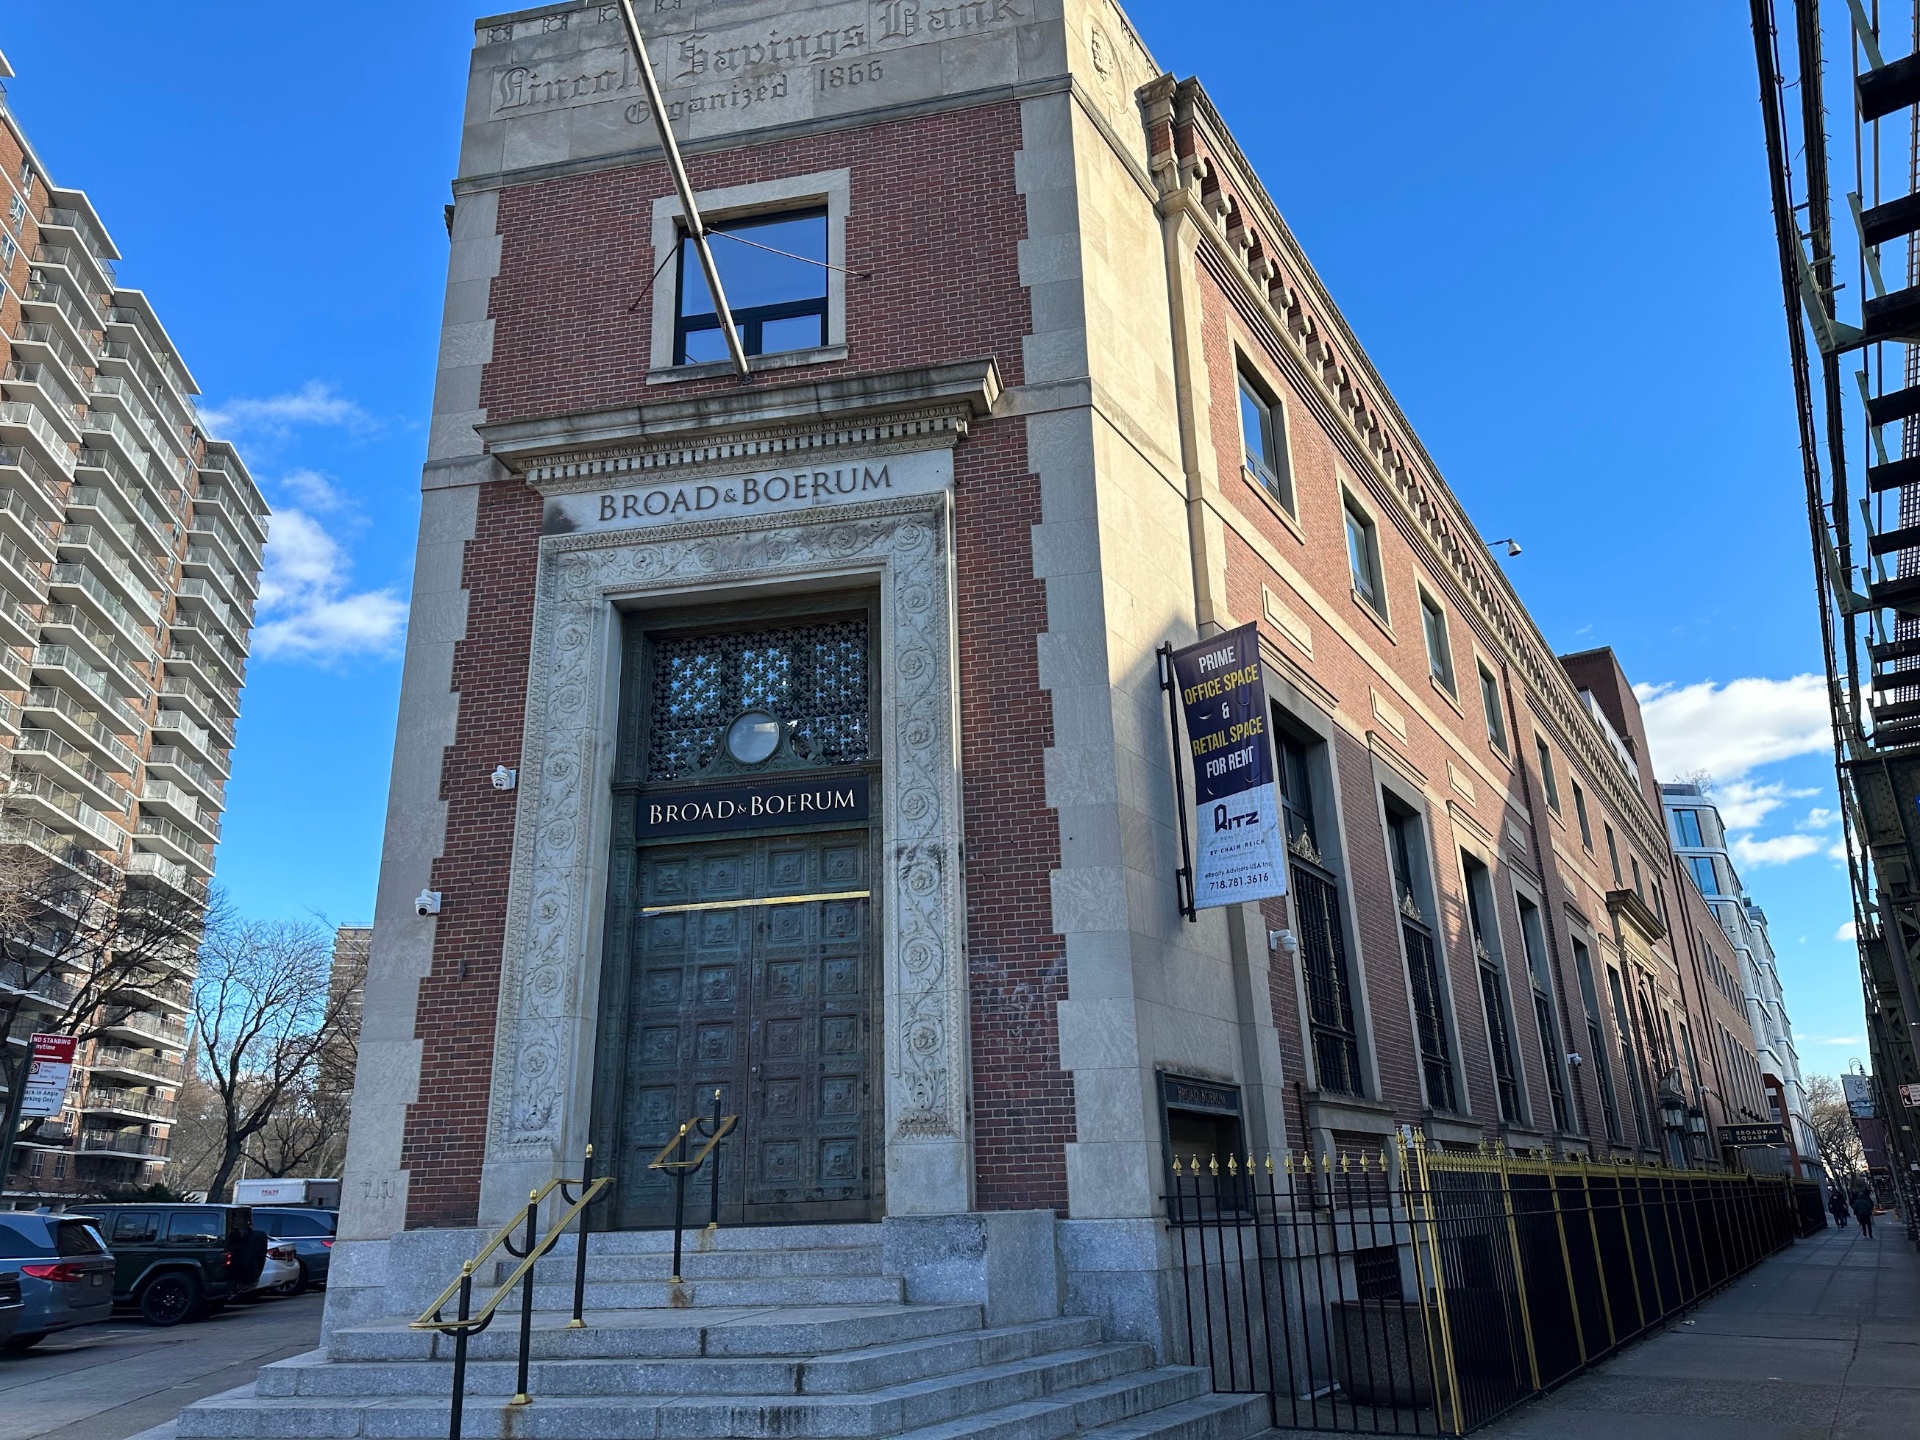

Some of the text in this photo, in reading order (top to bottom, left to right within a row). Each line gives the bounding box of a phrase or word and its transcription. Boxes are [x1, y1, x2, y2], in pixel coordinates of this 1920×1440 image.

[672, 22, 867, 82] Savings
[876, 0, 1026, 44] Bank
[624, 58, 885, 125] Oganized 1866
[1198, 645, 1236, 674] PRIME
[1183, 663, 1260, 706] OFFICE SPACE
[1221, 701, 1231, 720] &
[1191, 715, 1264, 757] RETAIL SPACE
[1205, 745, 1254, 779] FOR RENT
[1209, 873, 1269, 891] 718.781.3616
[1225, 865, 1249, 875] Advisors
[1249, 862, 1262, 870] USA
[43, 1037, 71, 1045] STANDING
